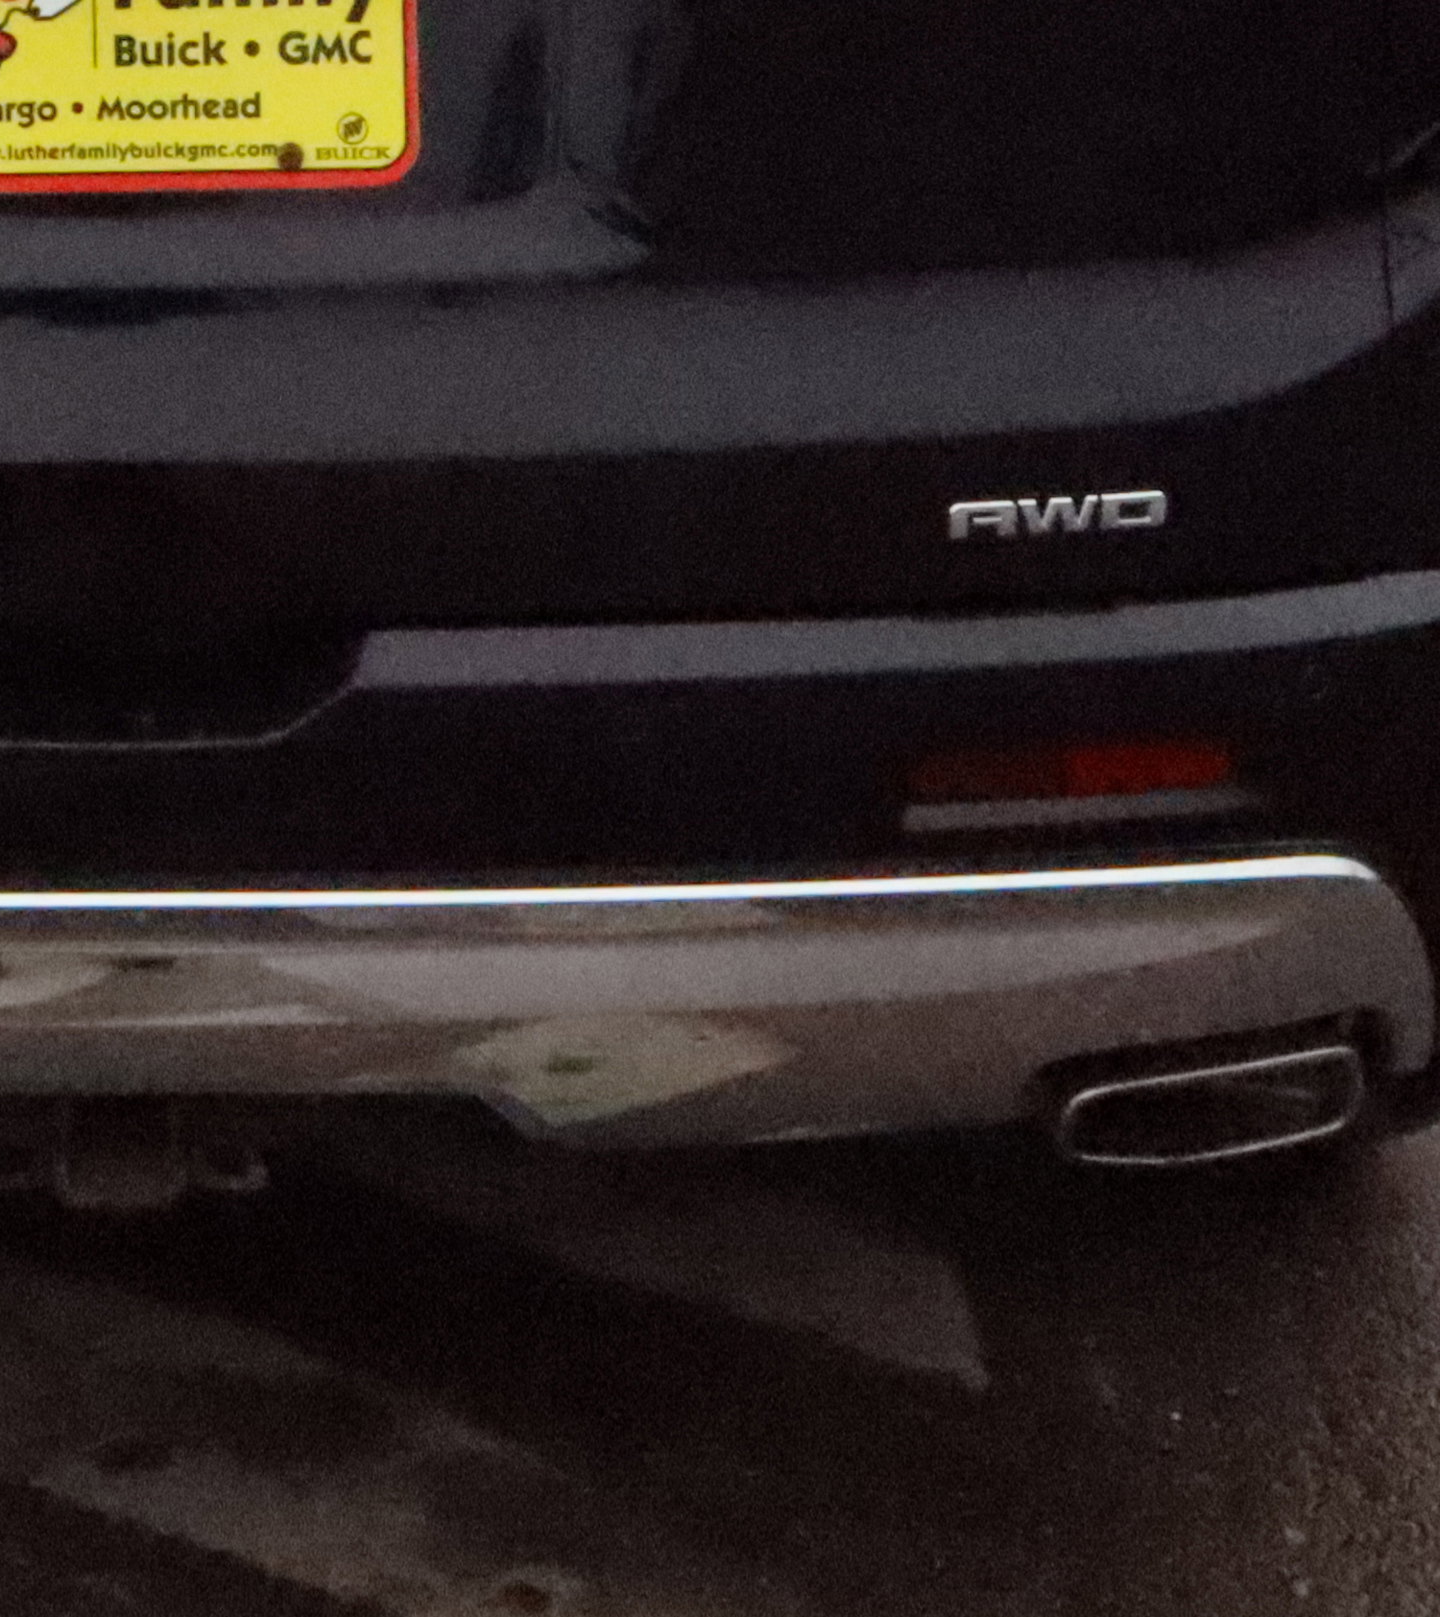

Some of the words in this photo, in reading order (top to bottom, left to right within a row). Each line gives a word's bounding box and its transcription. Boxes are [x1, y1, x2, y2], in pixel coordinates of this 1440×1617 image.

[114, 32, 227, 68] Buick
[278, 30, 372, 66] GMC
[97, 92, 262, 123] Moorhead
[315, 145, 391, 161] BUICK
[948, 489, 1167, 540] AWD
